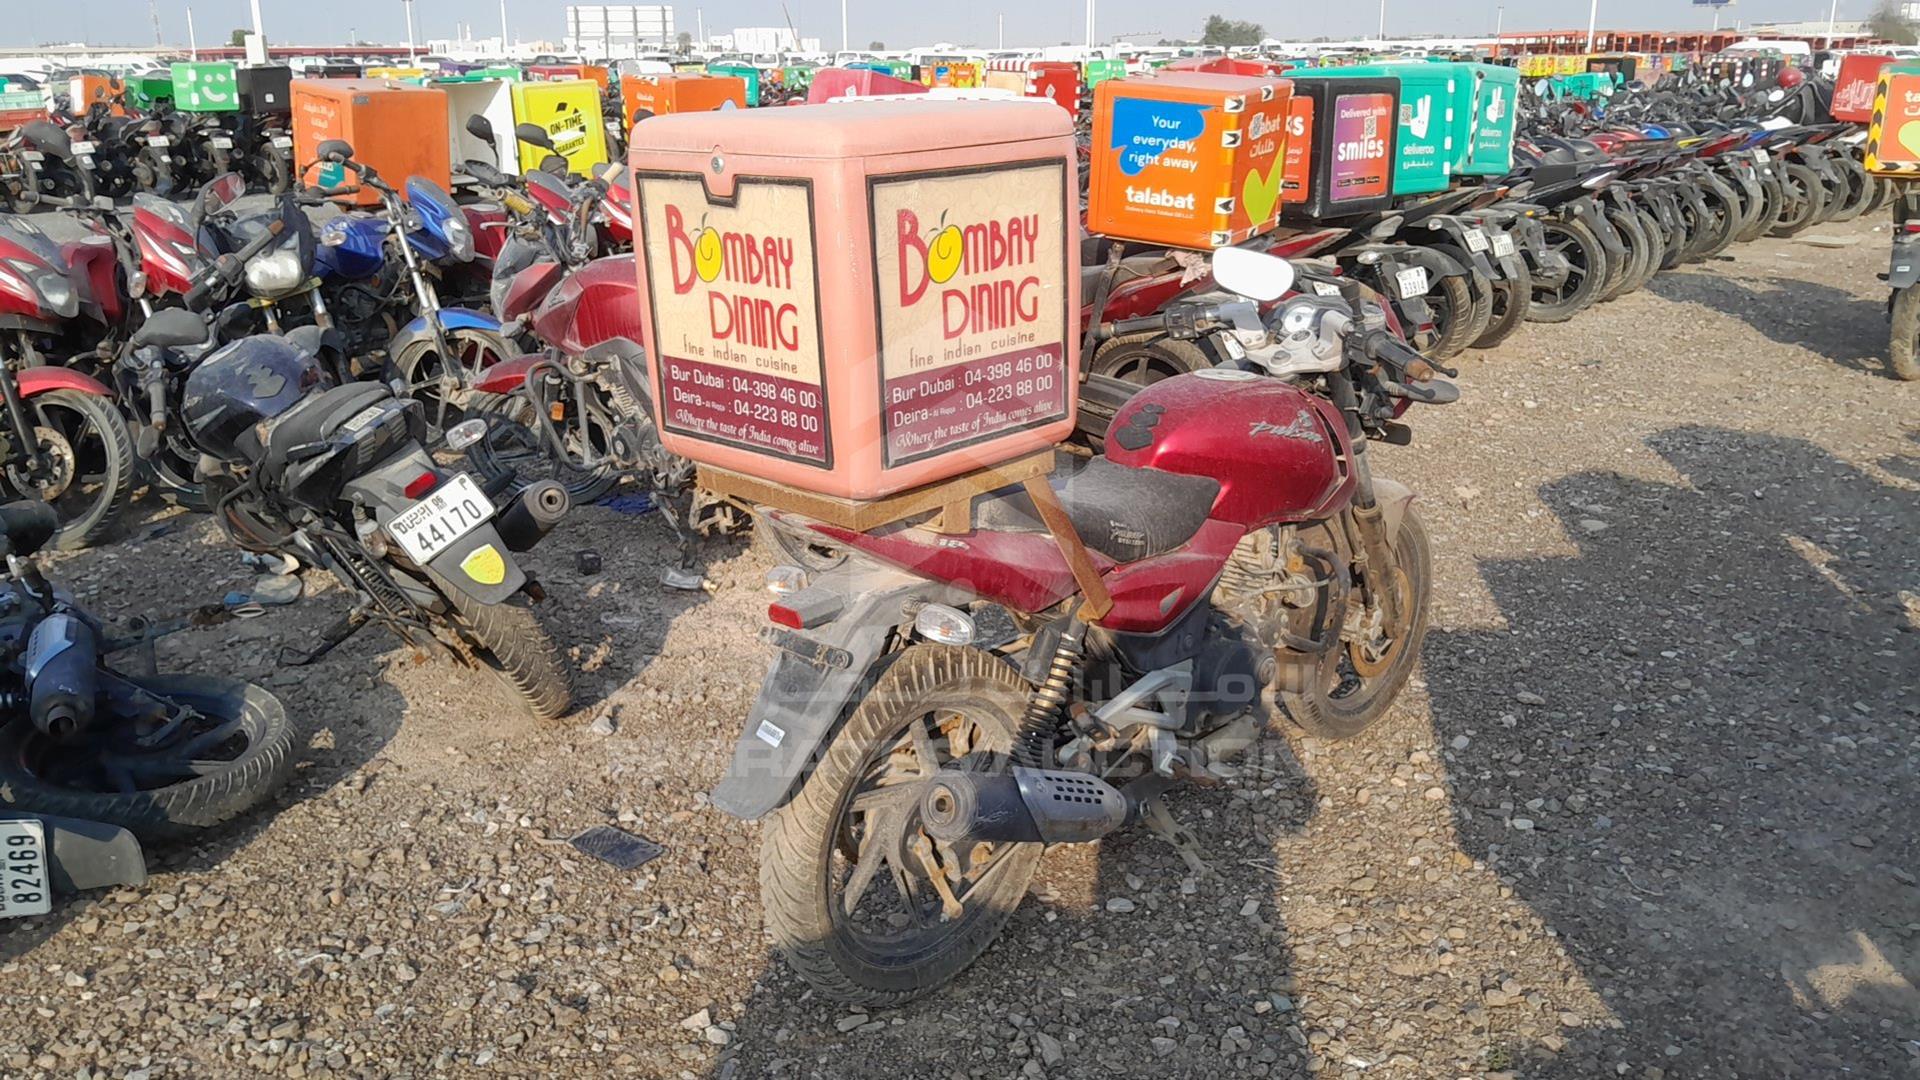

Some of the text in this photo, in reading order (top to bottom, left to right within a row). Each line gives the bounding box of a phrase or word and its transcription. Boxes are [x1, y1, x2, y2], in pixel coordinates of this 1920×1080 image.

[1152, 115, 1181, 129] Your
[1129, 151, 1198, 173] right away
[1133, 135, 1196, 153] everyday,
[1125, 185, 1195, 210] talabat
[708, 291, 799, 351] DINING
[941, 276, 1039, 340] DINING
[683, 334, 798, 374] fine indian cuisine
[910, 331, 1035, 368] fine indian cuisine
[671, 365, 691, 381] Bur
[694, 368, 724, 389] Dubai
[732, 376, 777, 400] 04-398
[779, 387, 796, 404] 46
[799, 390, 817, 409] 00
[893, 386, 916, 404] Bur
[920, 374, 955, 397] Dubai
[965, 361, 1012, 387] 04-398
[1015, 356, 1032, 373] 46
[1036, 352, 1053, 369] 00
[966, 385, 1012, 409] 04-223
[1016, 379, 1033, 396] 88
[1036, 374, 1053, 391] 00
[675, 408, 819, 455] Where the taste of India comes alive
[734, 399, 777, 423] 04-223
[781, 410, 798, 428] 88
[801, 414, 818, 432] 00
[896, 399, 1053, 449] Where the taste of India comes alive
[416, 499, 482, 551] 44170
[6, 835, 42, 903] 82469
